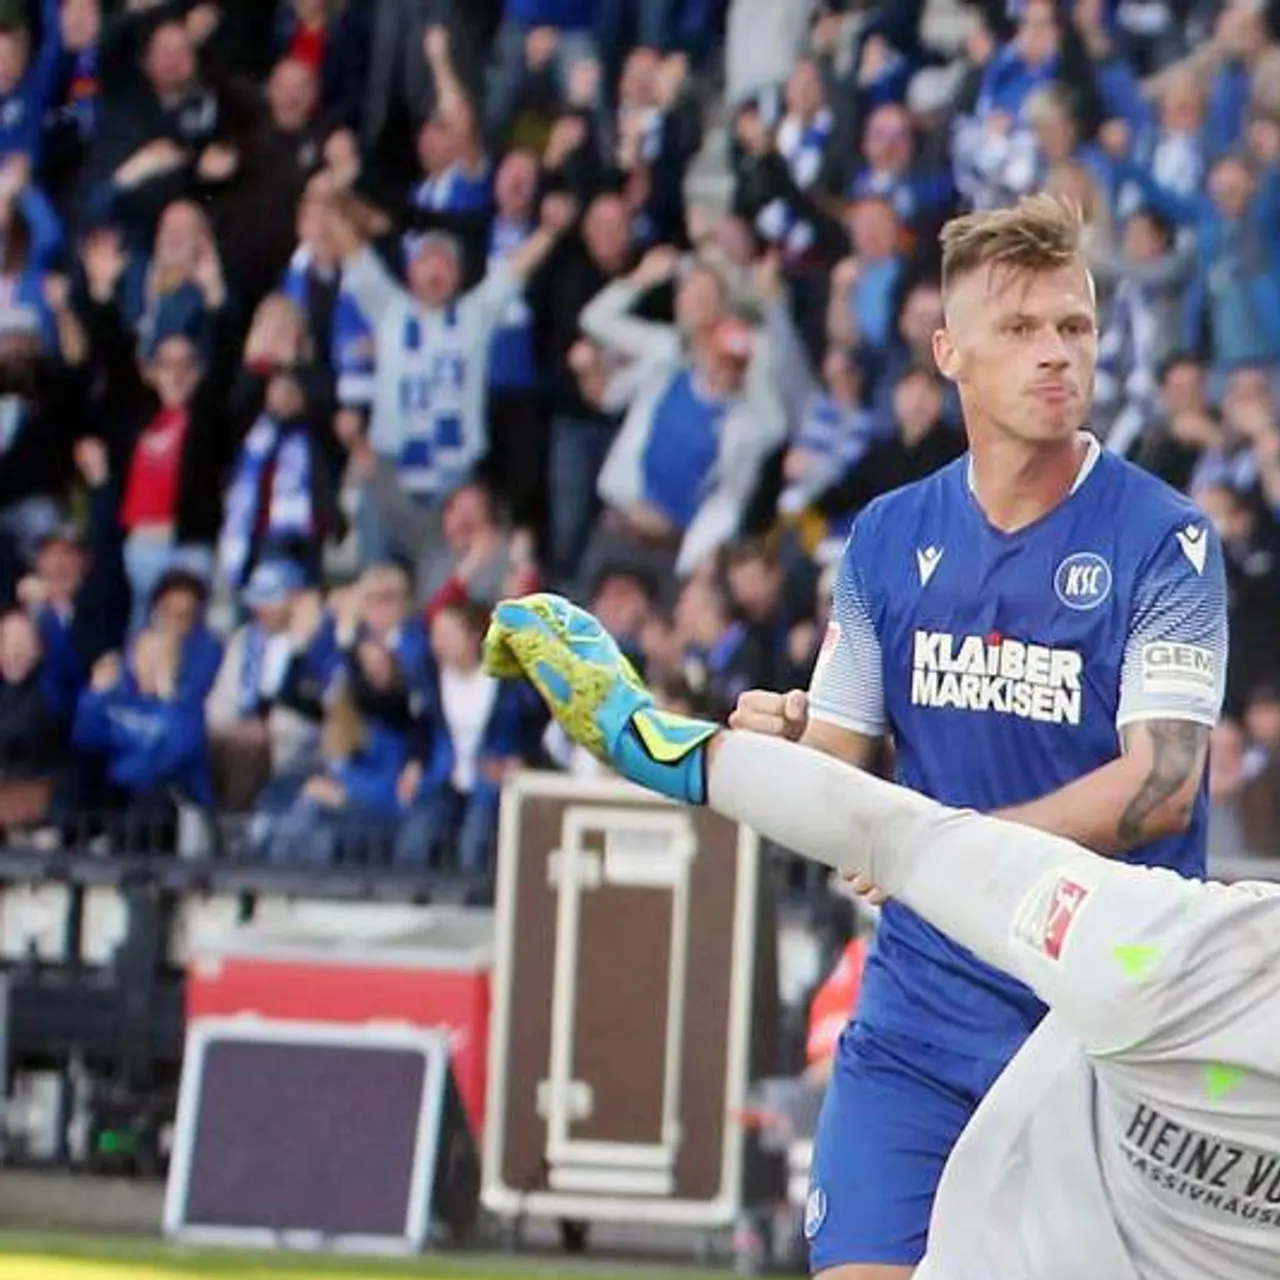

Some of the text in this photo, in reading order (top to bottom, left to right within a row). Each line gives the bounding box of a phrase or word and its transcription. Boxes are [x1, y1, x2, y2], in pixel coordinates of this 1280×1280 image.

[1065, 564, 1102, 595] KSC
[1146, 645, 1214, 673] GEM
[912, 671, 1082, 726] MARKISEN
[1126, 1104, 1244, 1189] HEINZ
